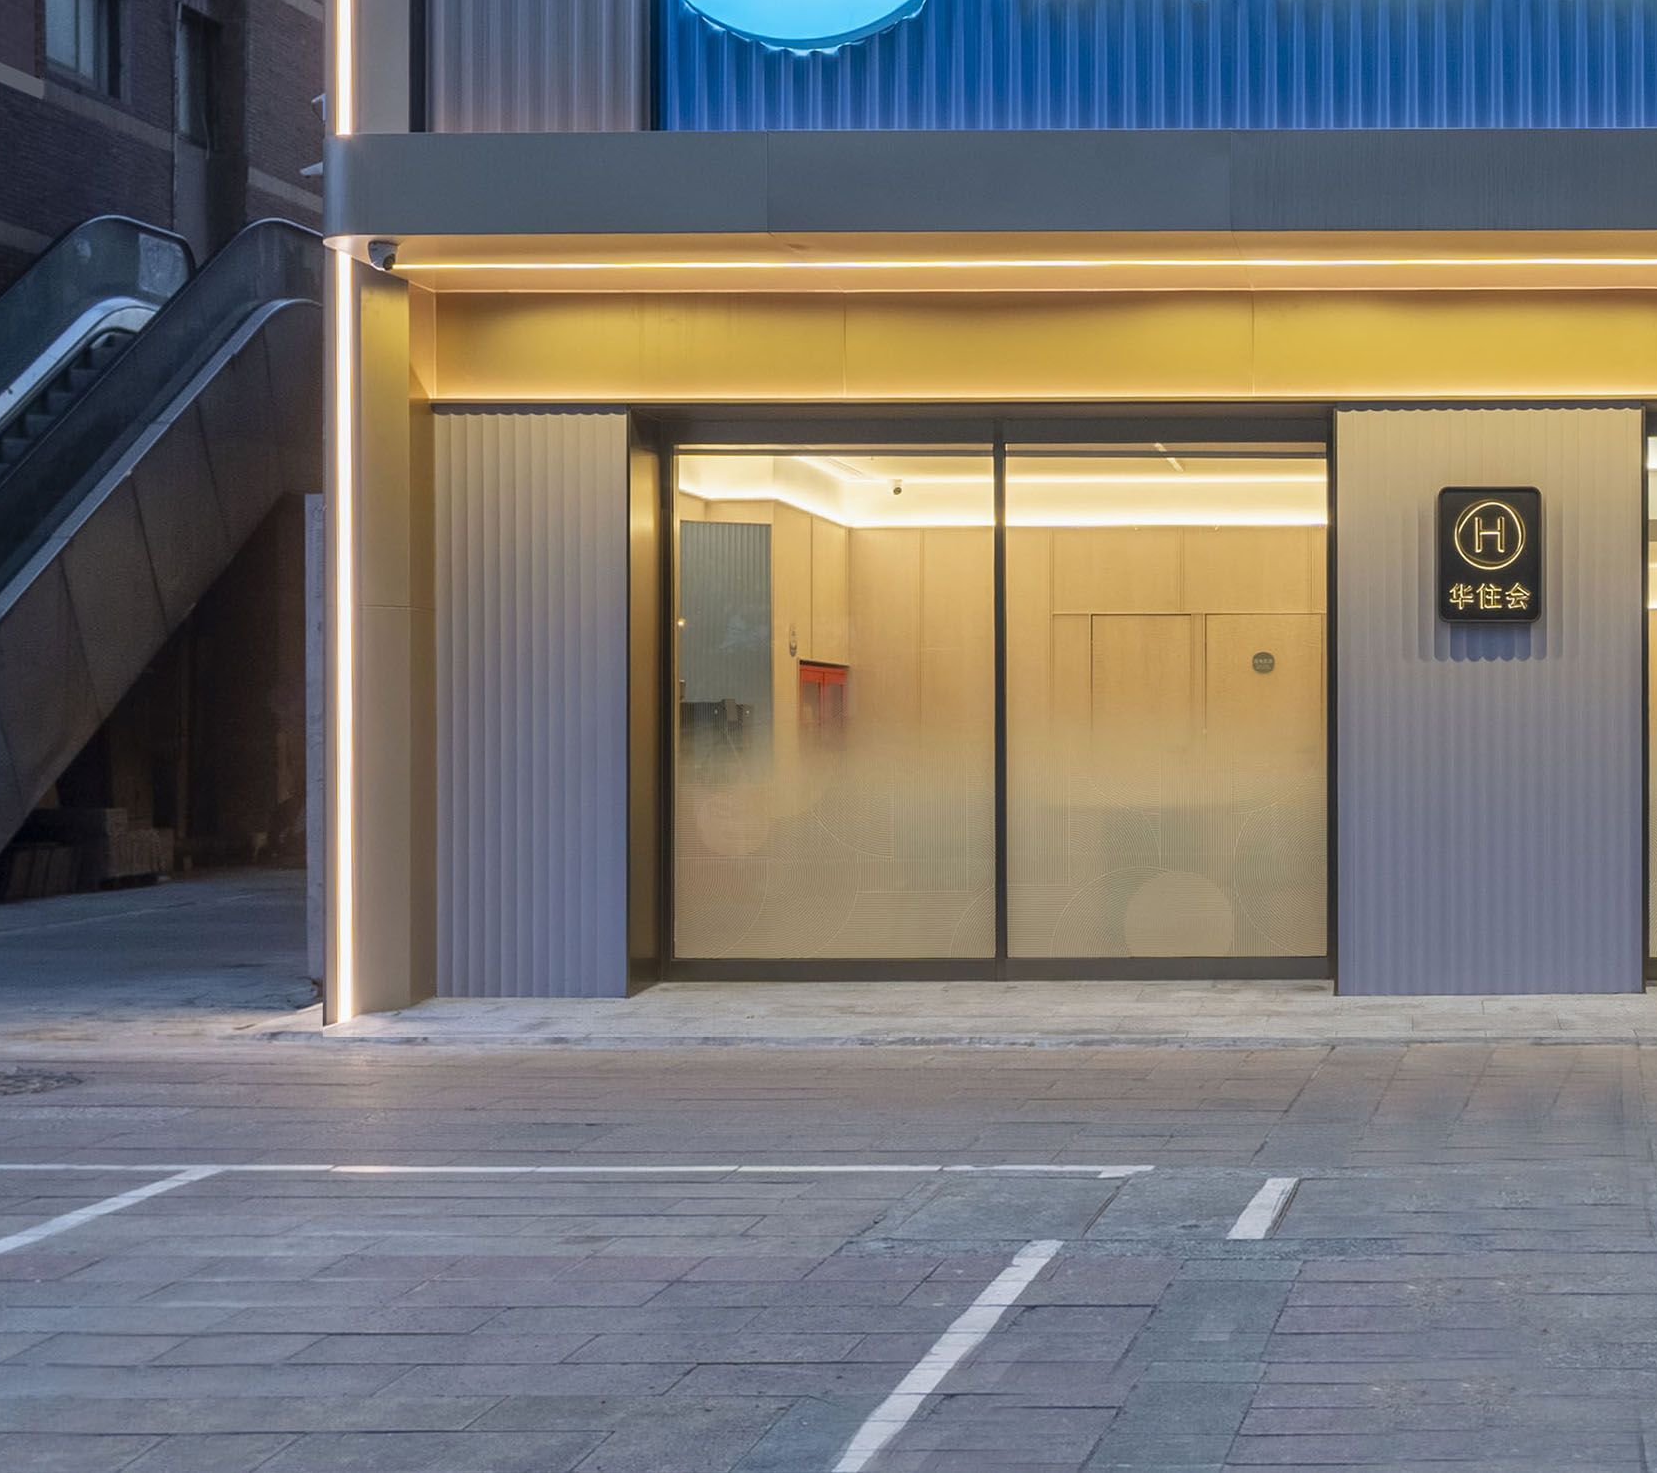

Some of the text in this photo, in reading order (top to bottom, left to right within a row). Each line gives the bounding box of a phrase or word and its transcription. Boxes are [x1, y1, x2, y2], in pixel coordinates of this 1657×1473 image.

[1474, 515, 1505, 553] H
[1449, 582, 1531, 610] 华住会
